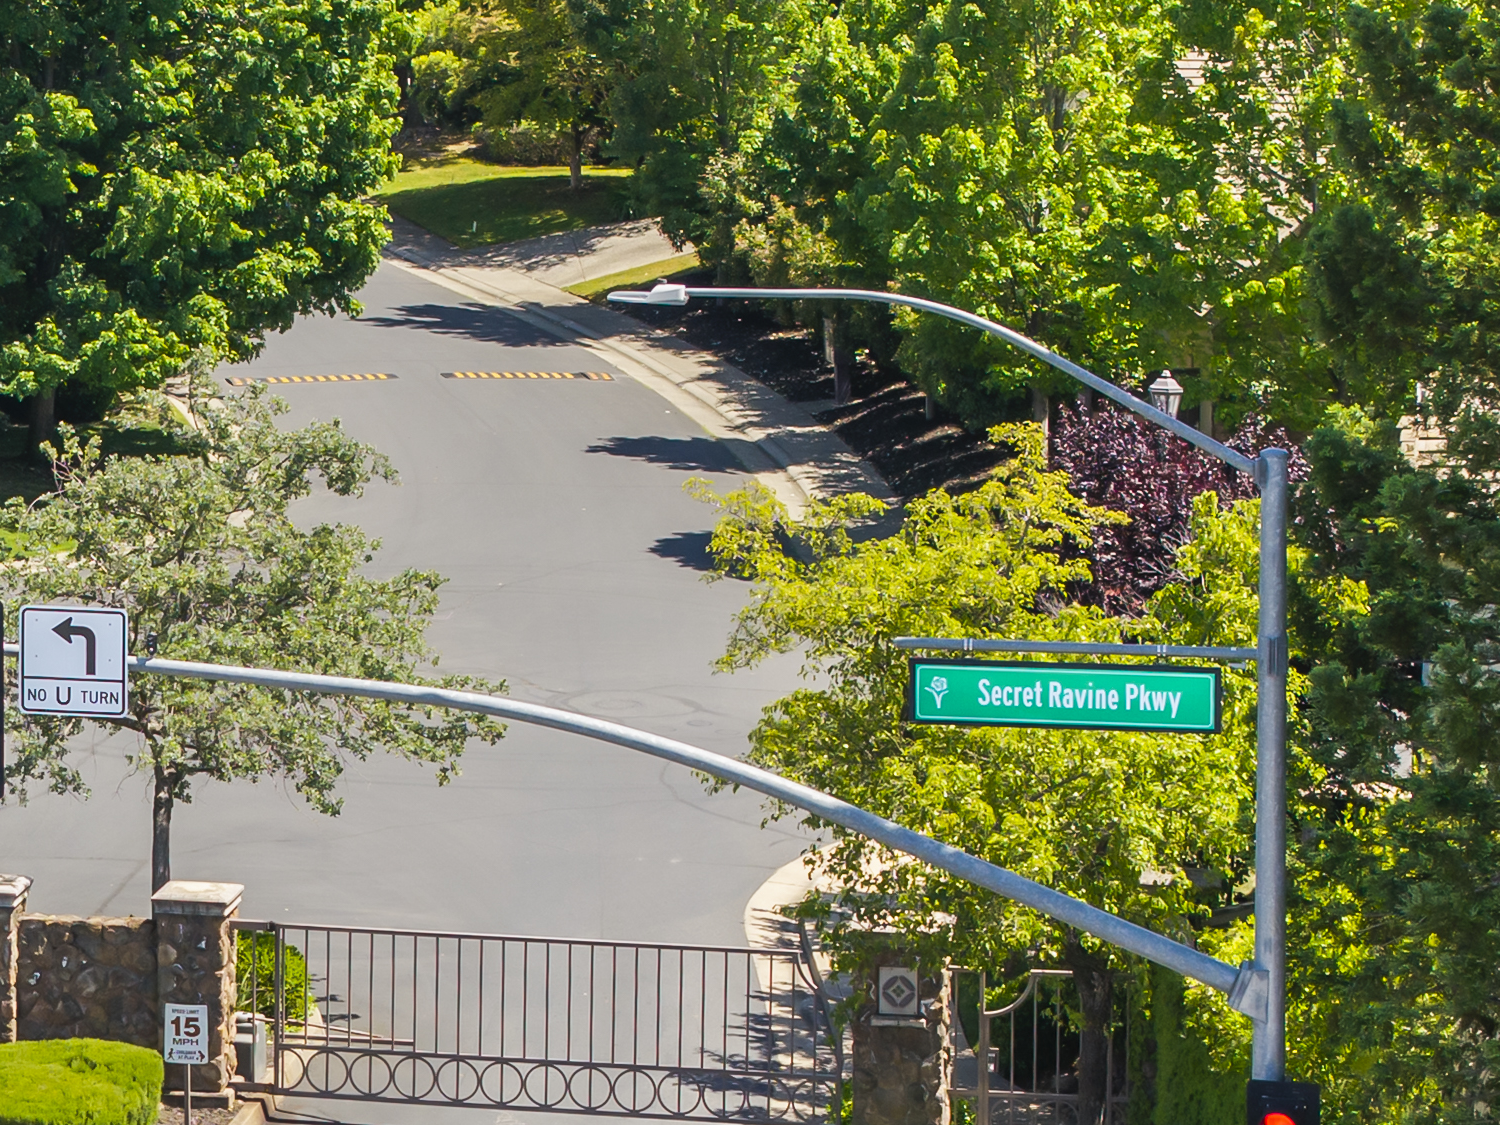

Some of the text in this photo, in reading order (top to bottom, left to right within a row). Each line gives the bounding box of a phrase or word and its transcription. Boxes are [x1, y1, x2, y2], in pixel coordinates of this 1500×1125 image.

[27, 686, 120, 705] NO U TURN
[977, 678, 1182, 719] Secret Ravine Pkwy
[171, 1016, 200, 1037] 15
